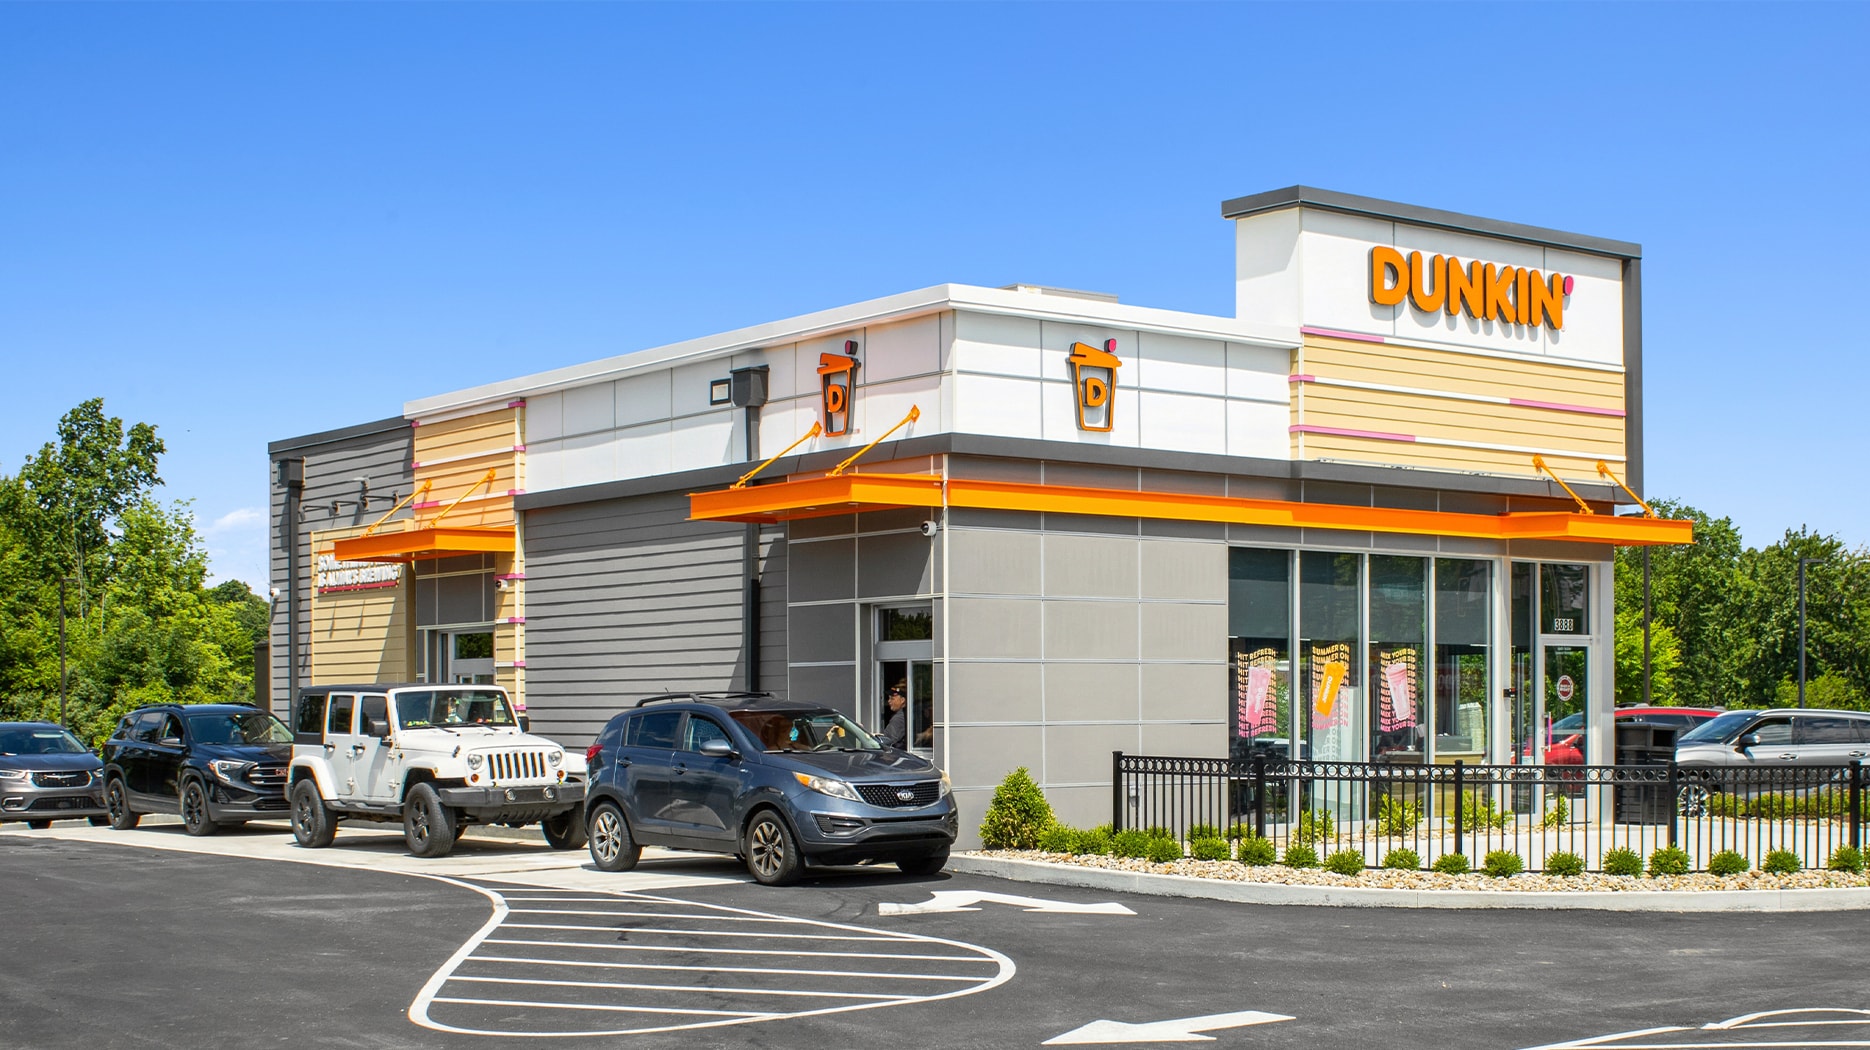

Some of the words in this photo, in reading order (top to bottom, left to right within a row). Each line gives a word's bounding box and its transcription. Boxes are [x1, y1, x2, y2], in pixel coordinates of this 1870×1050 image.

[1369, 246, 1574, 330] DUNKIN'
[828, 384, 845, 413] D
[1086, 377, 1107, 407] D
[1237, 651, 1248, 661] HIT
[1250, 647, 1276, 660] REFRESH
[1312, 644, 1338, 656] SUMMER
[1340, 643, 1350, 654] ON
